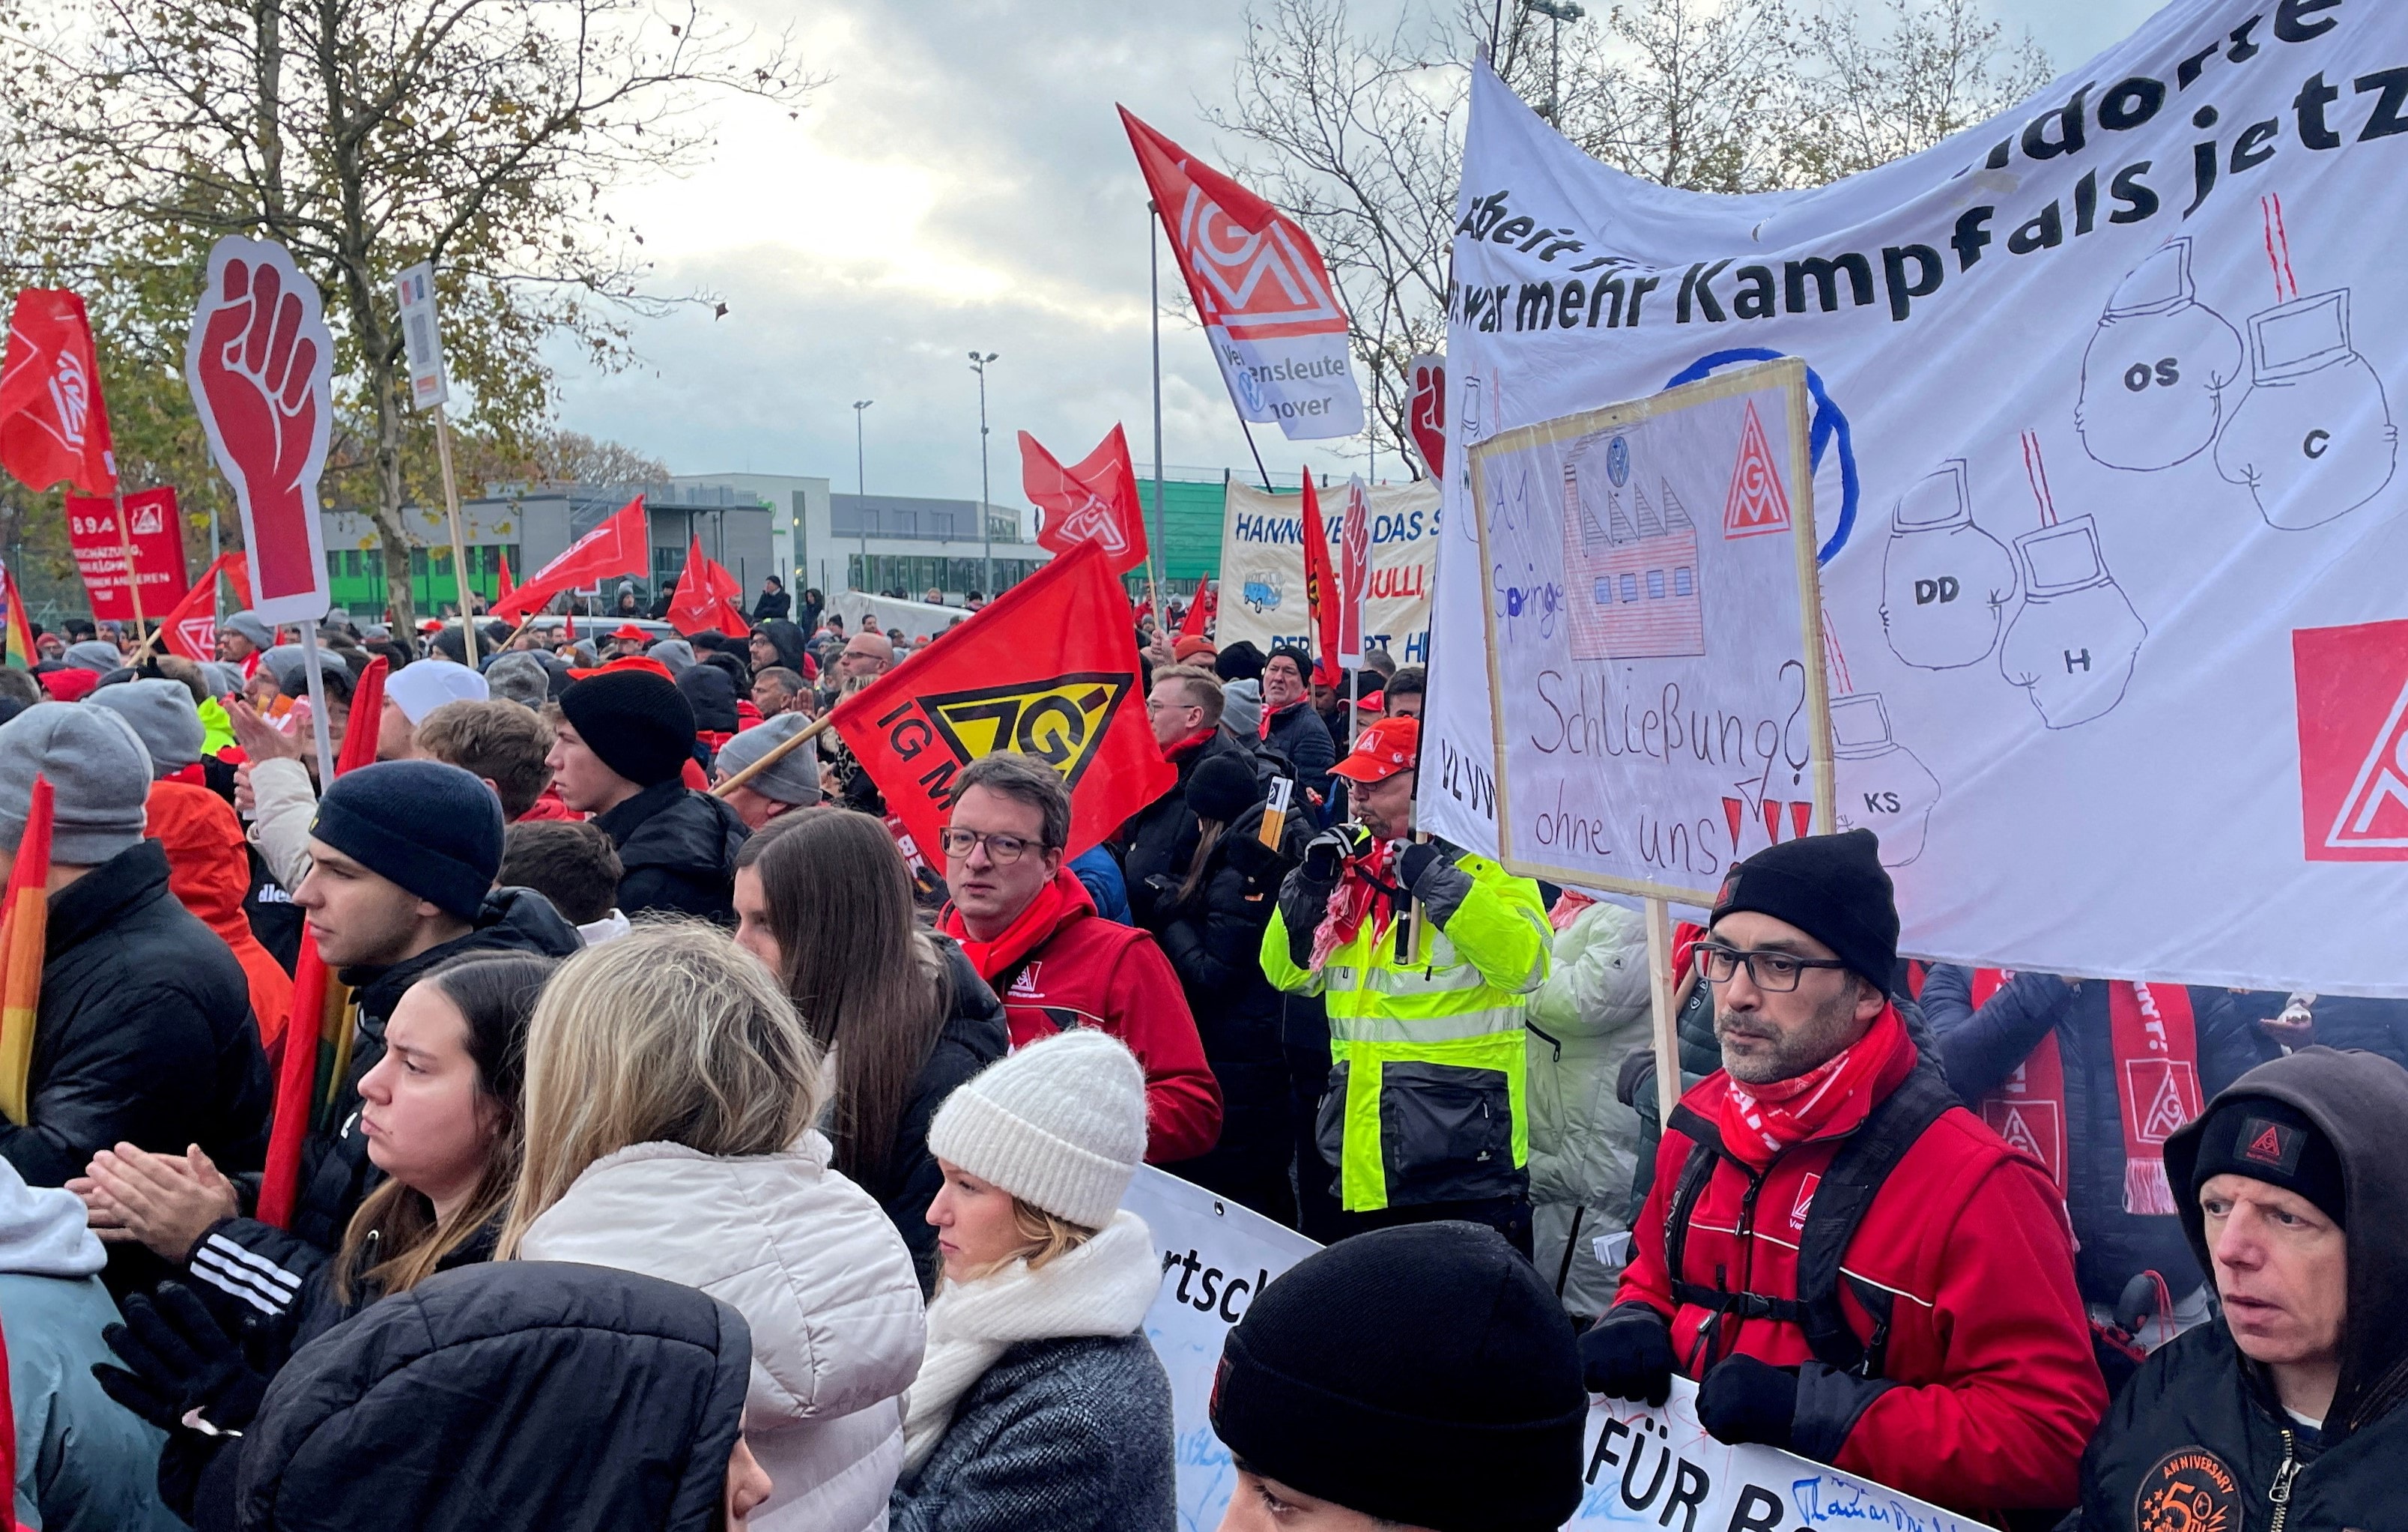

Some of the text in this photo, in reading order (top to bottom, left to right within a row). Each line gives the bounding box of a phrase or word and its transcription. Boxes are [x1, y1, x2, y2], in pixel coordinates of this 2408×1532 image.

[1951, 0, 2342, 179] dorte
[1464, 284, 1511, 333] war
[1516, 268, 1661, 332] mehr
[1676, 205, 1995, 324] Kampf
[2007, 160, 2159, 255] als
[2125, 357, 2180, 392] OS
[1268, 396, 1332, 420] nover
[2303, 430, 2331, 459] C
[1373, 510, 1424, 543] DAS
[1493, 563, 1565, 644] Springe
[1915, 577, 1960, 604] DD
[2064, 649, 2091, 674] H
[918, 759, 957, 812] M
[1863, 791, 1902, 814] KS
[1535, 778, 1613, 856] ohne
[1157, 1249, 1268, 1324] rtsc
[1585, 1417, 1710, 1532] FÜR
[2163, 1454, 2235, 1494] ANNIVERSARY
